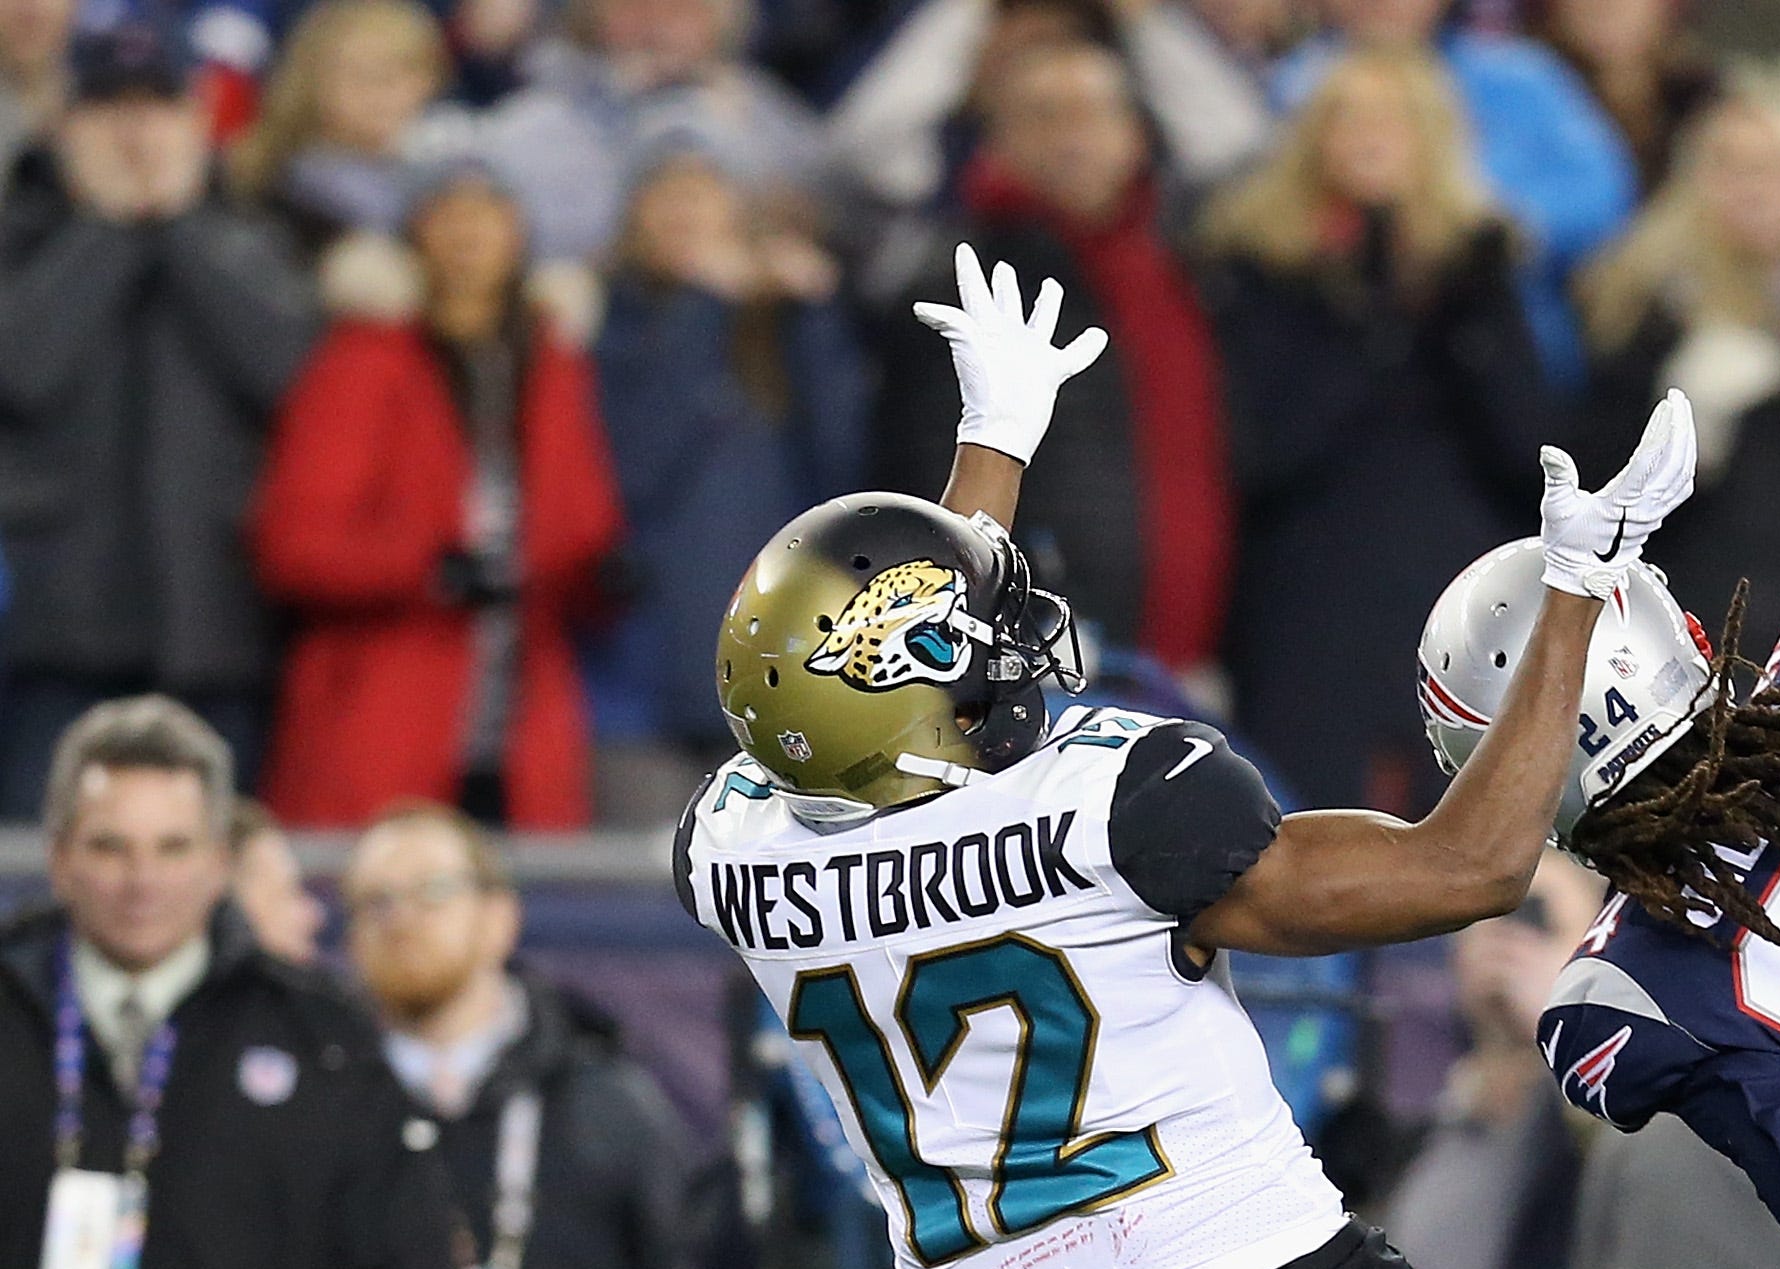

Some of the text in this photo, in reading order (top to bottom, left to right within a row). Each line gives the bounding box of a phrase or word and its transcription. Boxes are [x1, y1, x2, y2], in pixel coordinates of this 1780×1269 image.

[1578, 686, 1639, 758] 24
[711, 811, 1094, 950] WESTBROOK
[788, 931, 1176, 1268] 12
